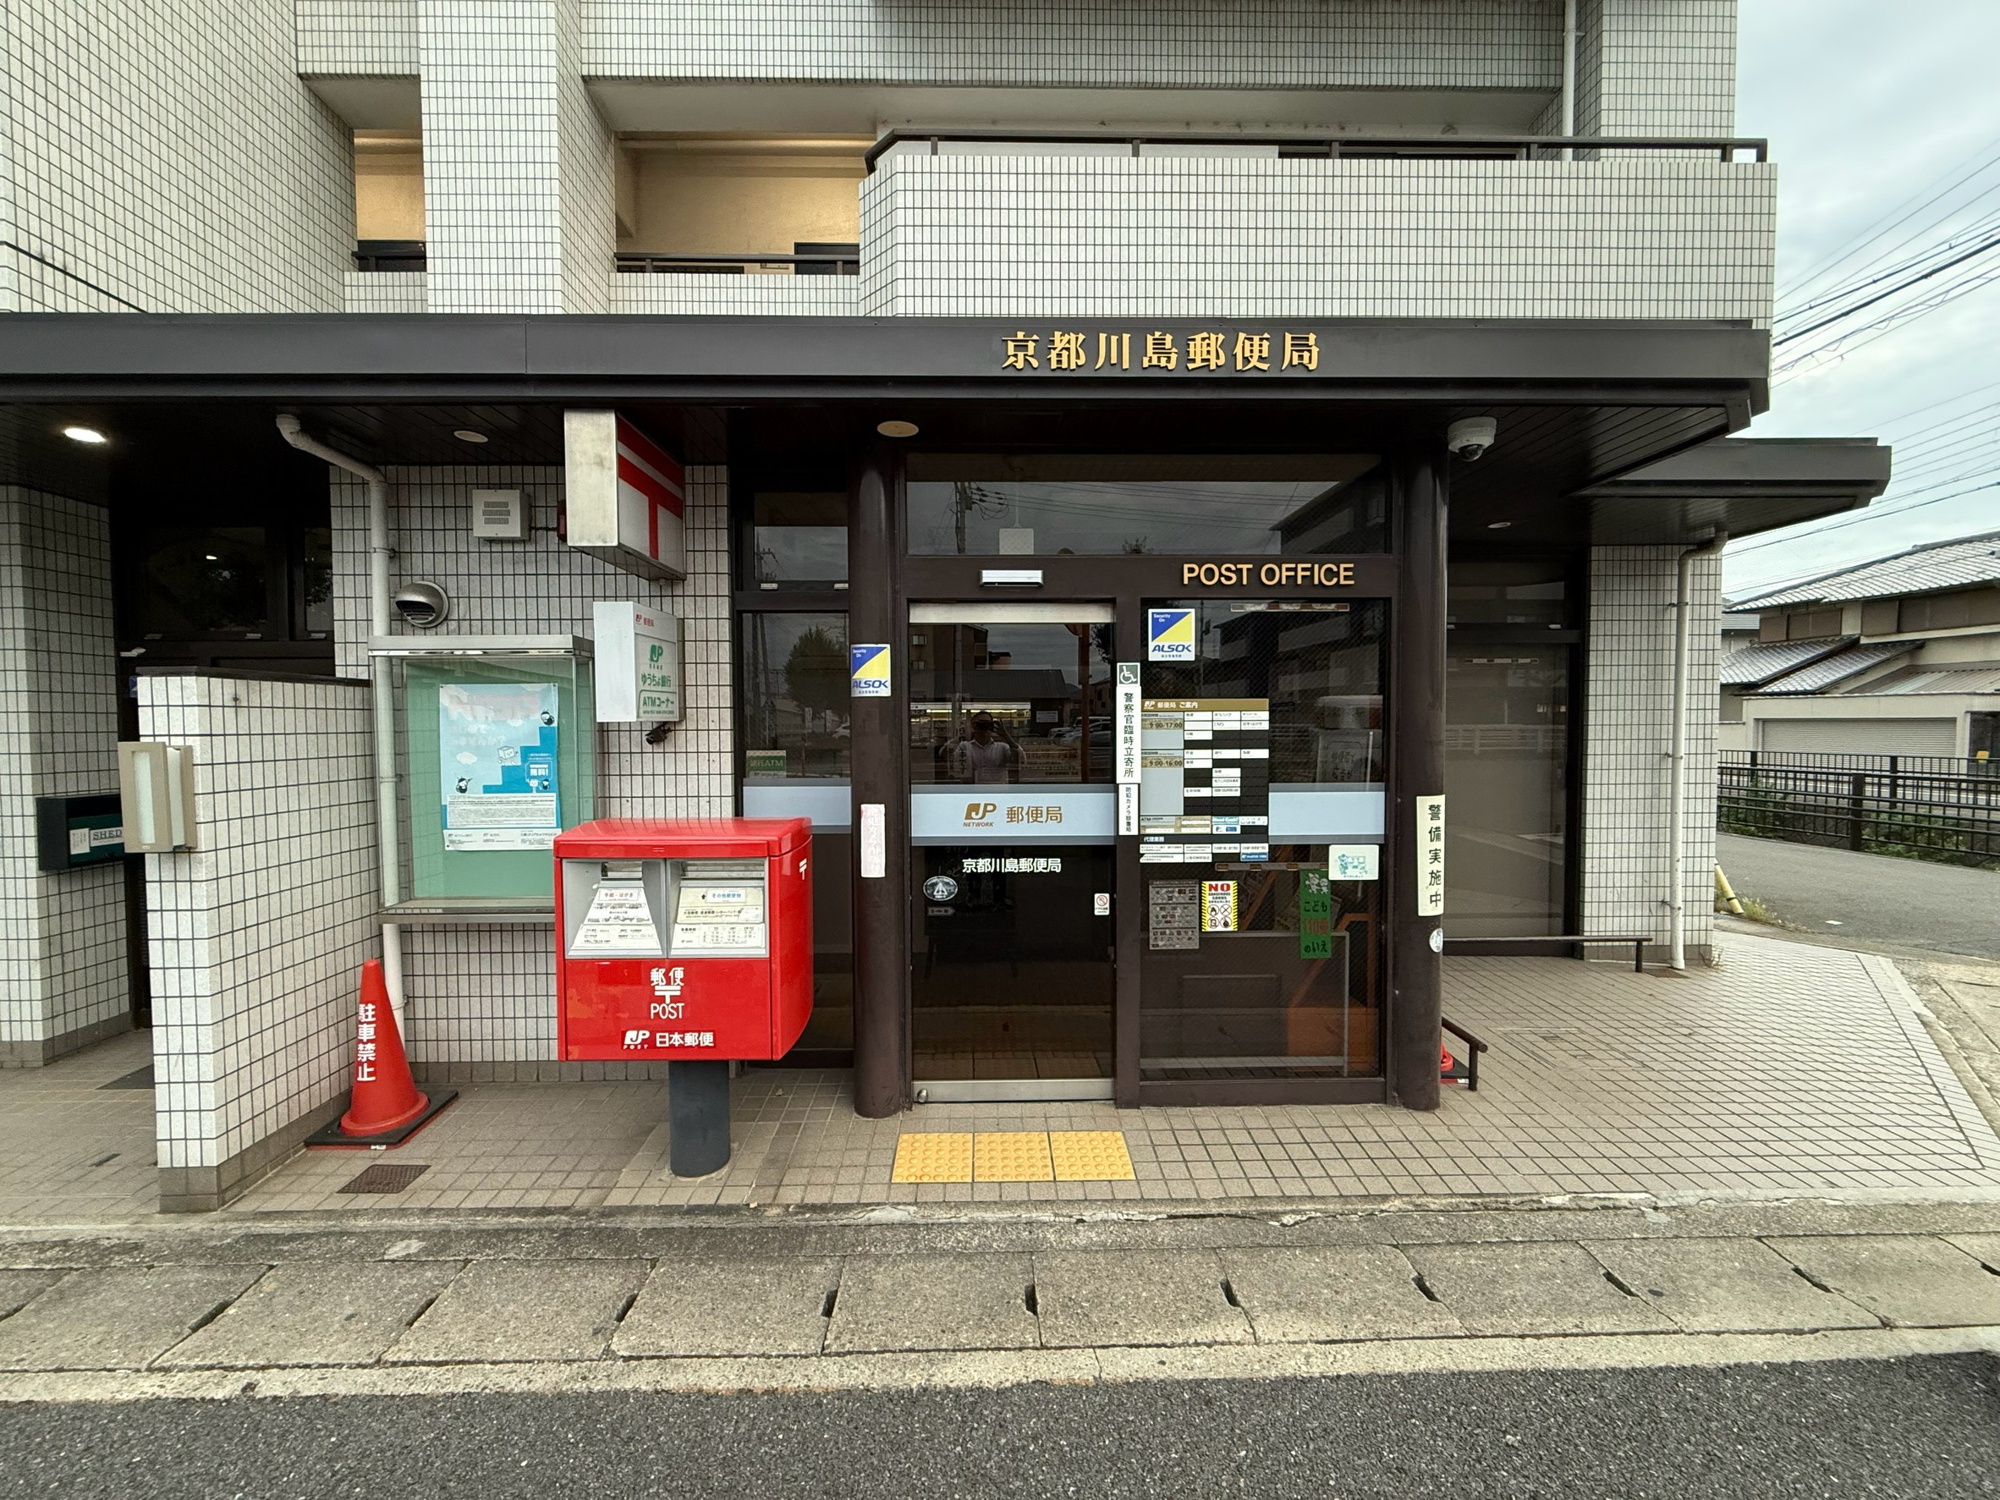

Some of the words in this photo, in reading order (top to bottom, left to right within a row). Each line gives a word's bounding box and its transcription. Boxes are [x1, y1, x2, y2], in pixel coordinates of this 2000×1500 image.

[1001, 331, 1320, 372] 京都川島郵便局
[1182, 563, 1253, 586] POST
[1260, 563, 1355, 586] OFFICE
[1151, 644, 1192, 653] ALSOK
[641, 672, 672, 688] ゆうちょ銀行
[852, 679, 889, 689] ALSOK
[642, 696, 675, 708] ATMコーナー
[1123, 692, 1135, 778] 警察官臨時立寄所
[1006, 805, 1063, 824] 郵便局
[1428, 804, 1442, 908] 警備実施中
[962, 857, 1062, 873] 京都川島郵便局
[1208, 883, 1231, 892] NO
[1303, 900, 1328, 913] こども
[1304, 941, 1328, 953] のいえ
[650, 967, 685, 986] 郵便
[650, 1003, 685, 1019] POST
[356, 1003, 377, 1082] 駐車禁止
[656, 1032, 715, 1047] 日本郵便
